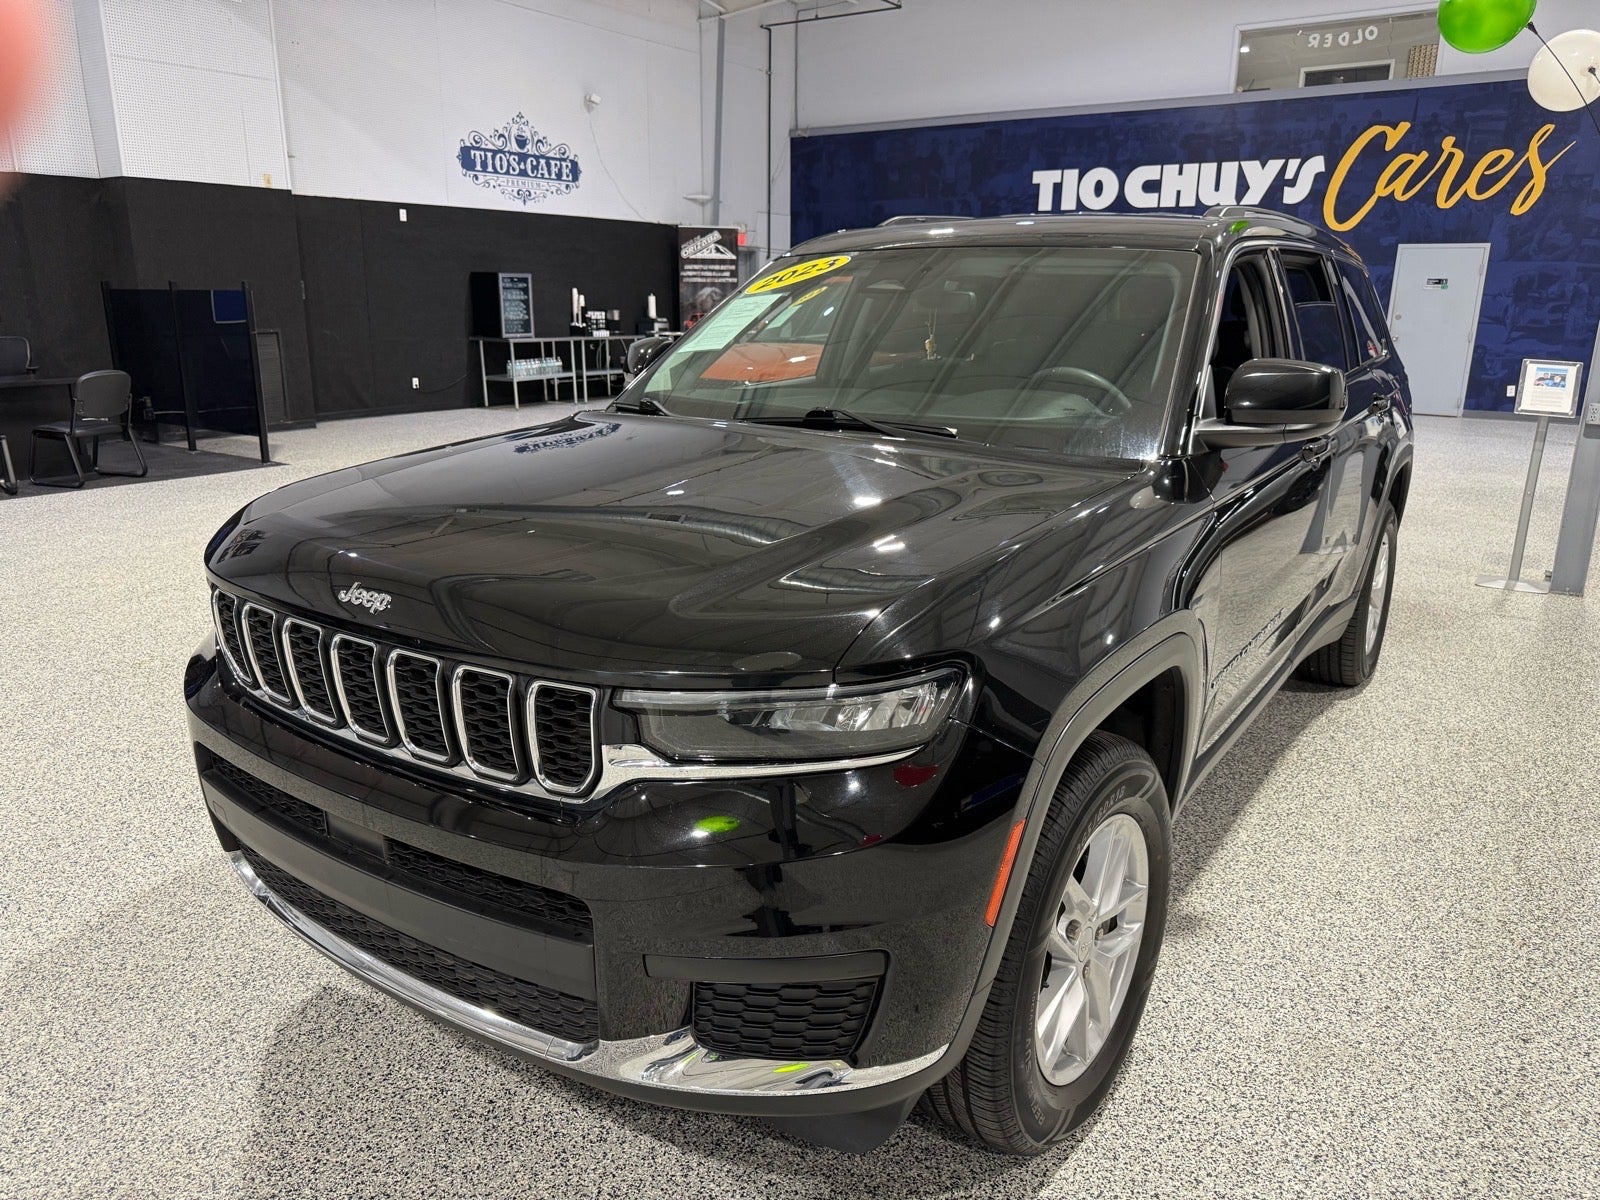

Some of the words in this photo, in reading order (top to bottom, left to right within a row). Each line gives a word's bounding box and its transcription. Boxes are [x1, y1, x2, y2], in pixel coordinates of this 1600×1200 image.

[470, 149, 520, 175] TIO'S
[1032, 168, 1119, 211] TIO
[1124, 155, 1325, 209] CHUY'S
[1323, 121, 1577, 232] Cares
[506, 179, 541, 188] PREMIUM
[753, 258, 841, 291] 2023
[338, 581, 392, 615] Jeep
